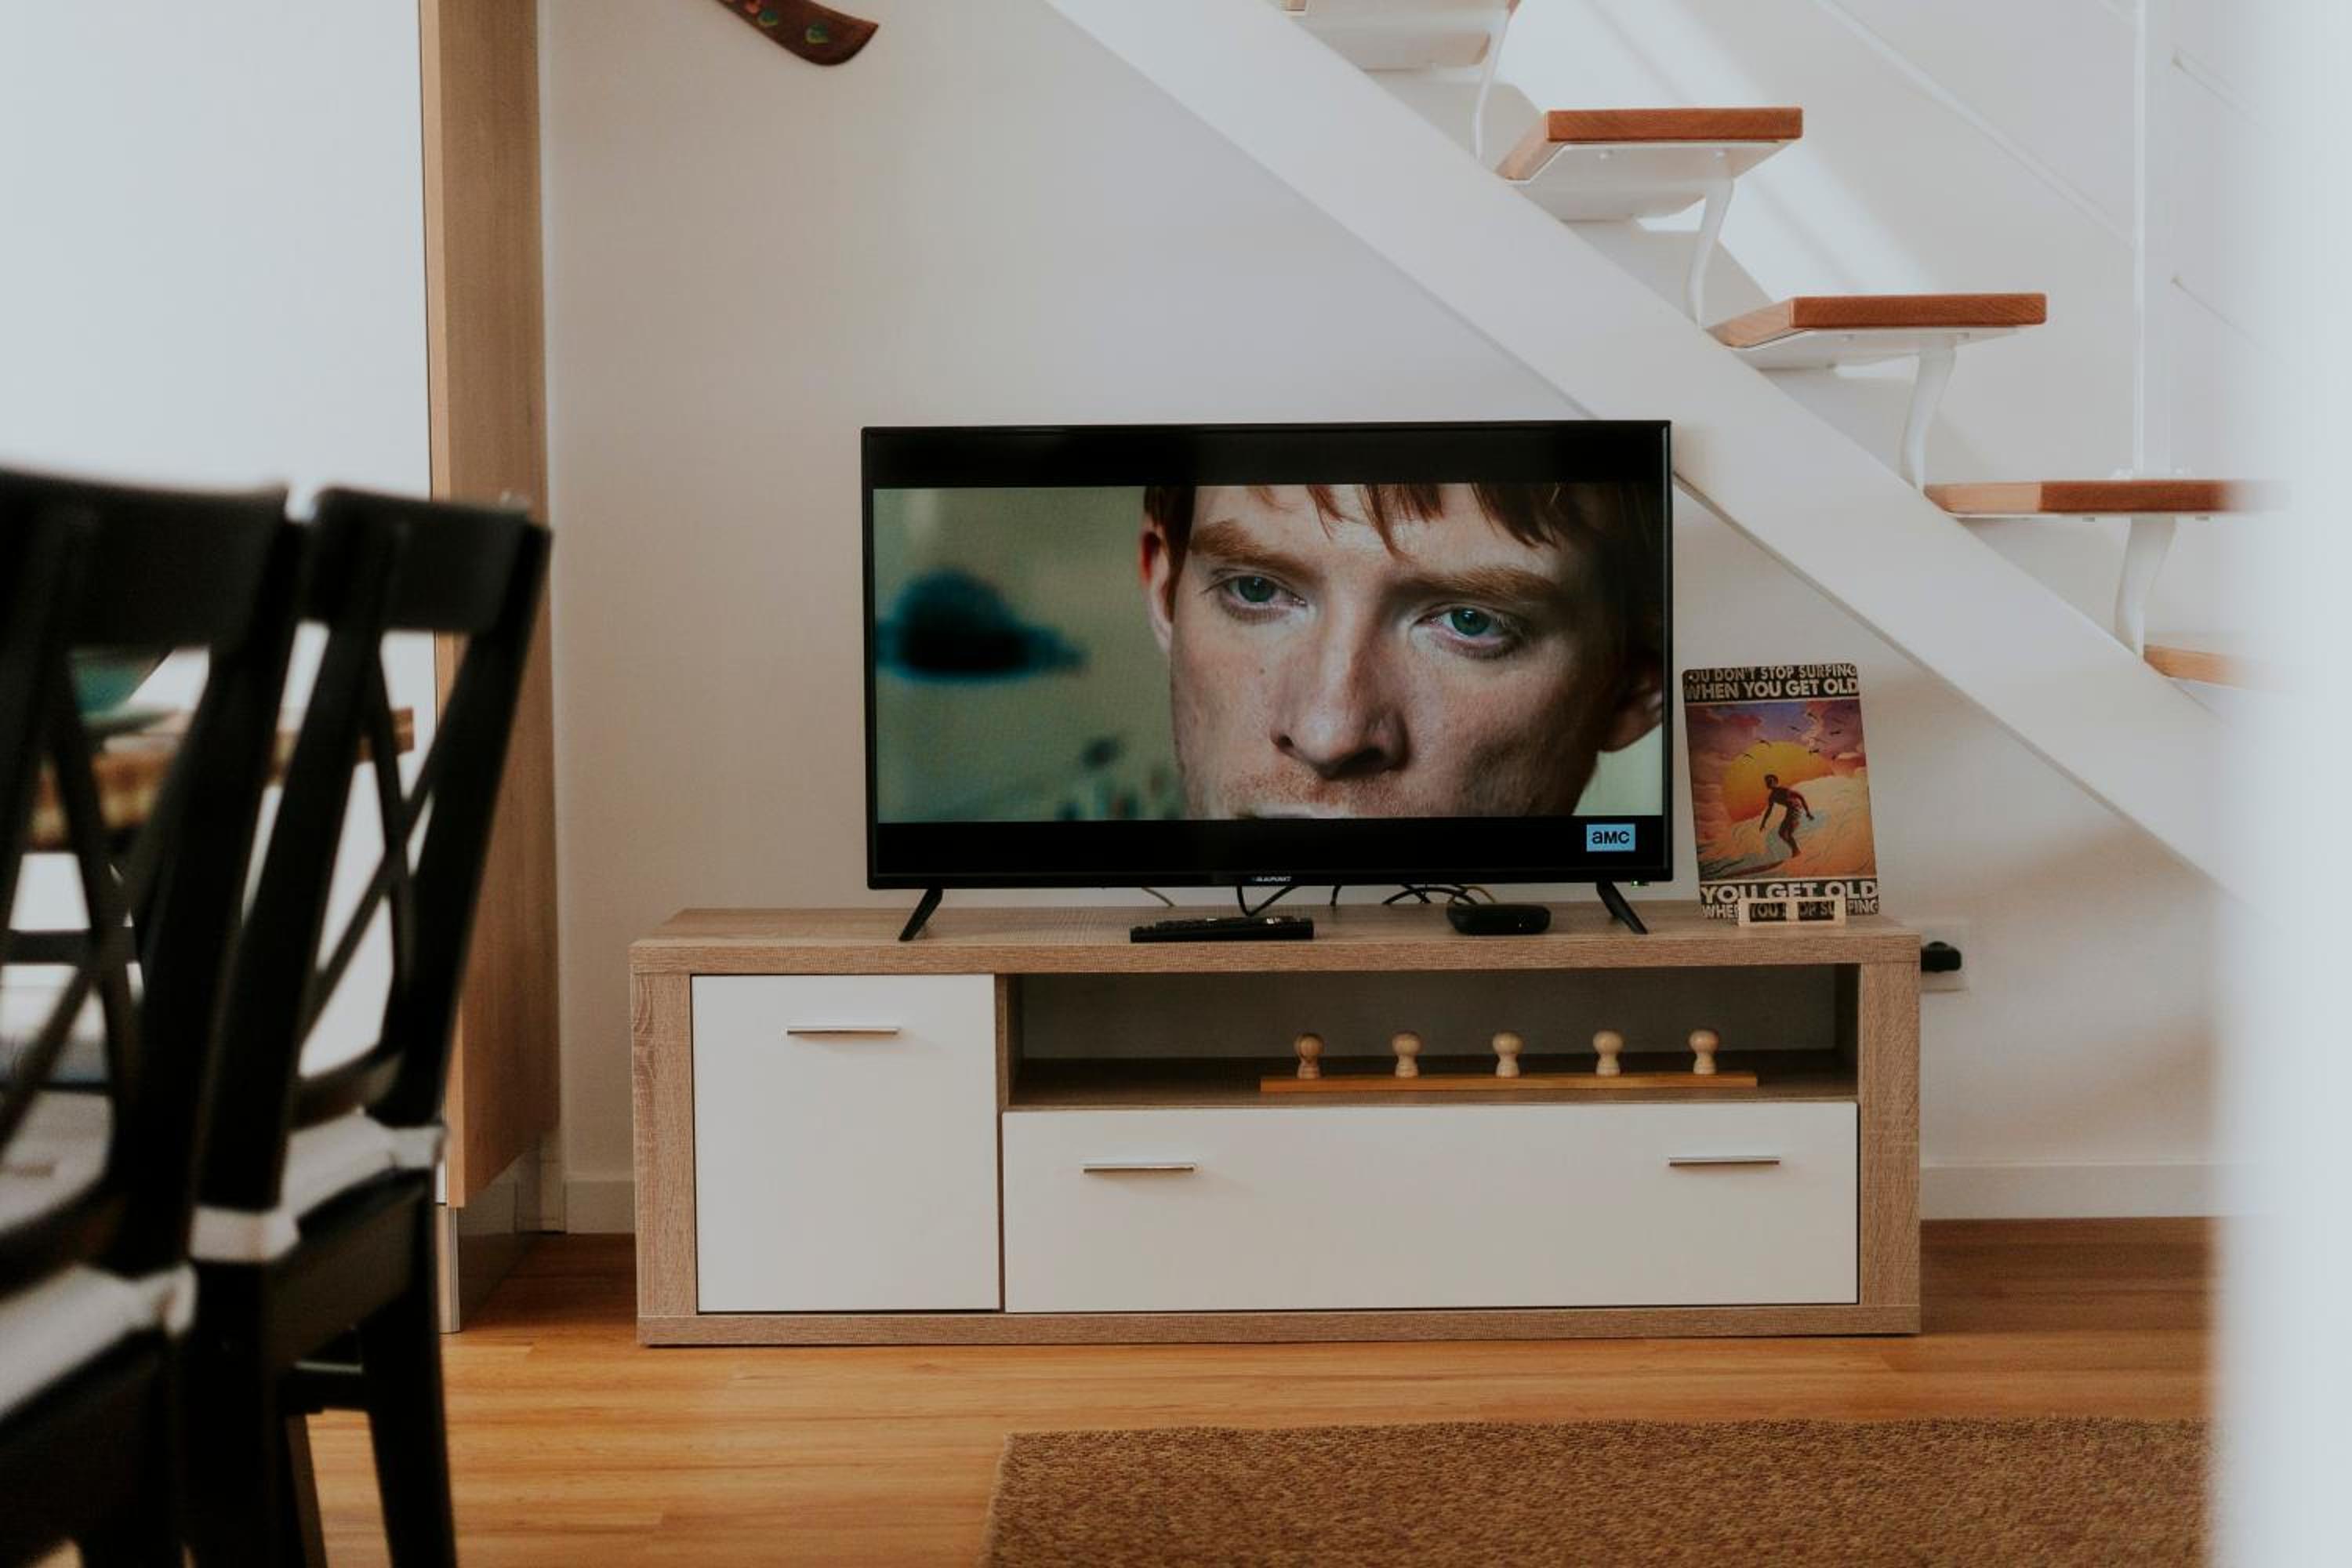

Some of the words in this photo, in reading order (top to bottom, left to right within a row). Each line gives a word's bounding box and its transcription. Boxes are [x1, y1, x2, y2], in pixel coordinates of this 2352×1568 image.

[1761, 665, 1795, 680] STOP
[1798, 663, 1857, 678] SURFING
[1683, 682, 1740, 700] WHEN
[1743, 679, 1782, 698] YOU
[1785, 678, 1819, 696] GET
[1823, 677, 1857, 695] OLD
[1700, 884, 1758, 904] YOU
[1765, 882, 1817, 899] GET
[1824, 880, 1878, 900] OLD
